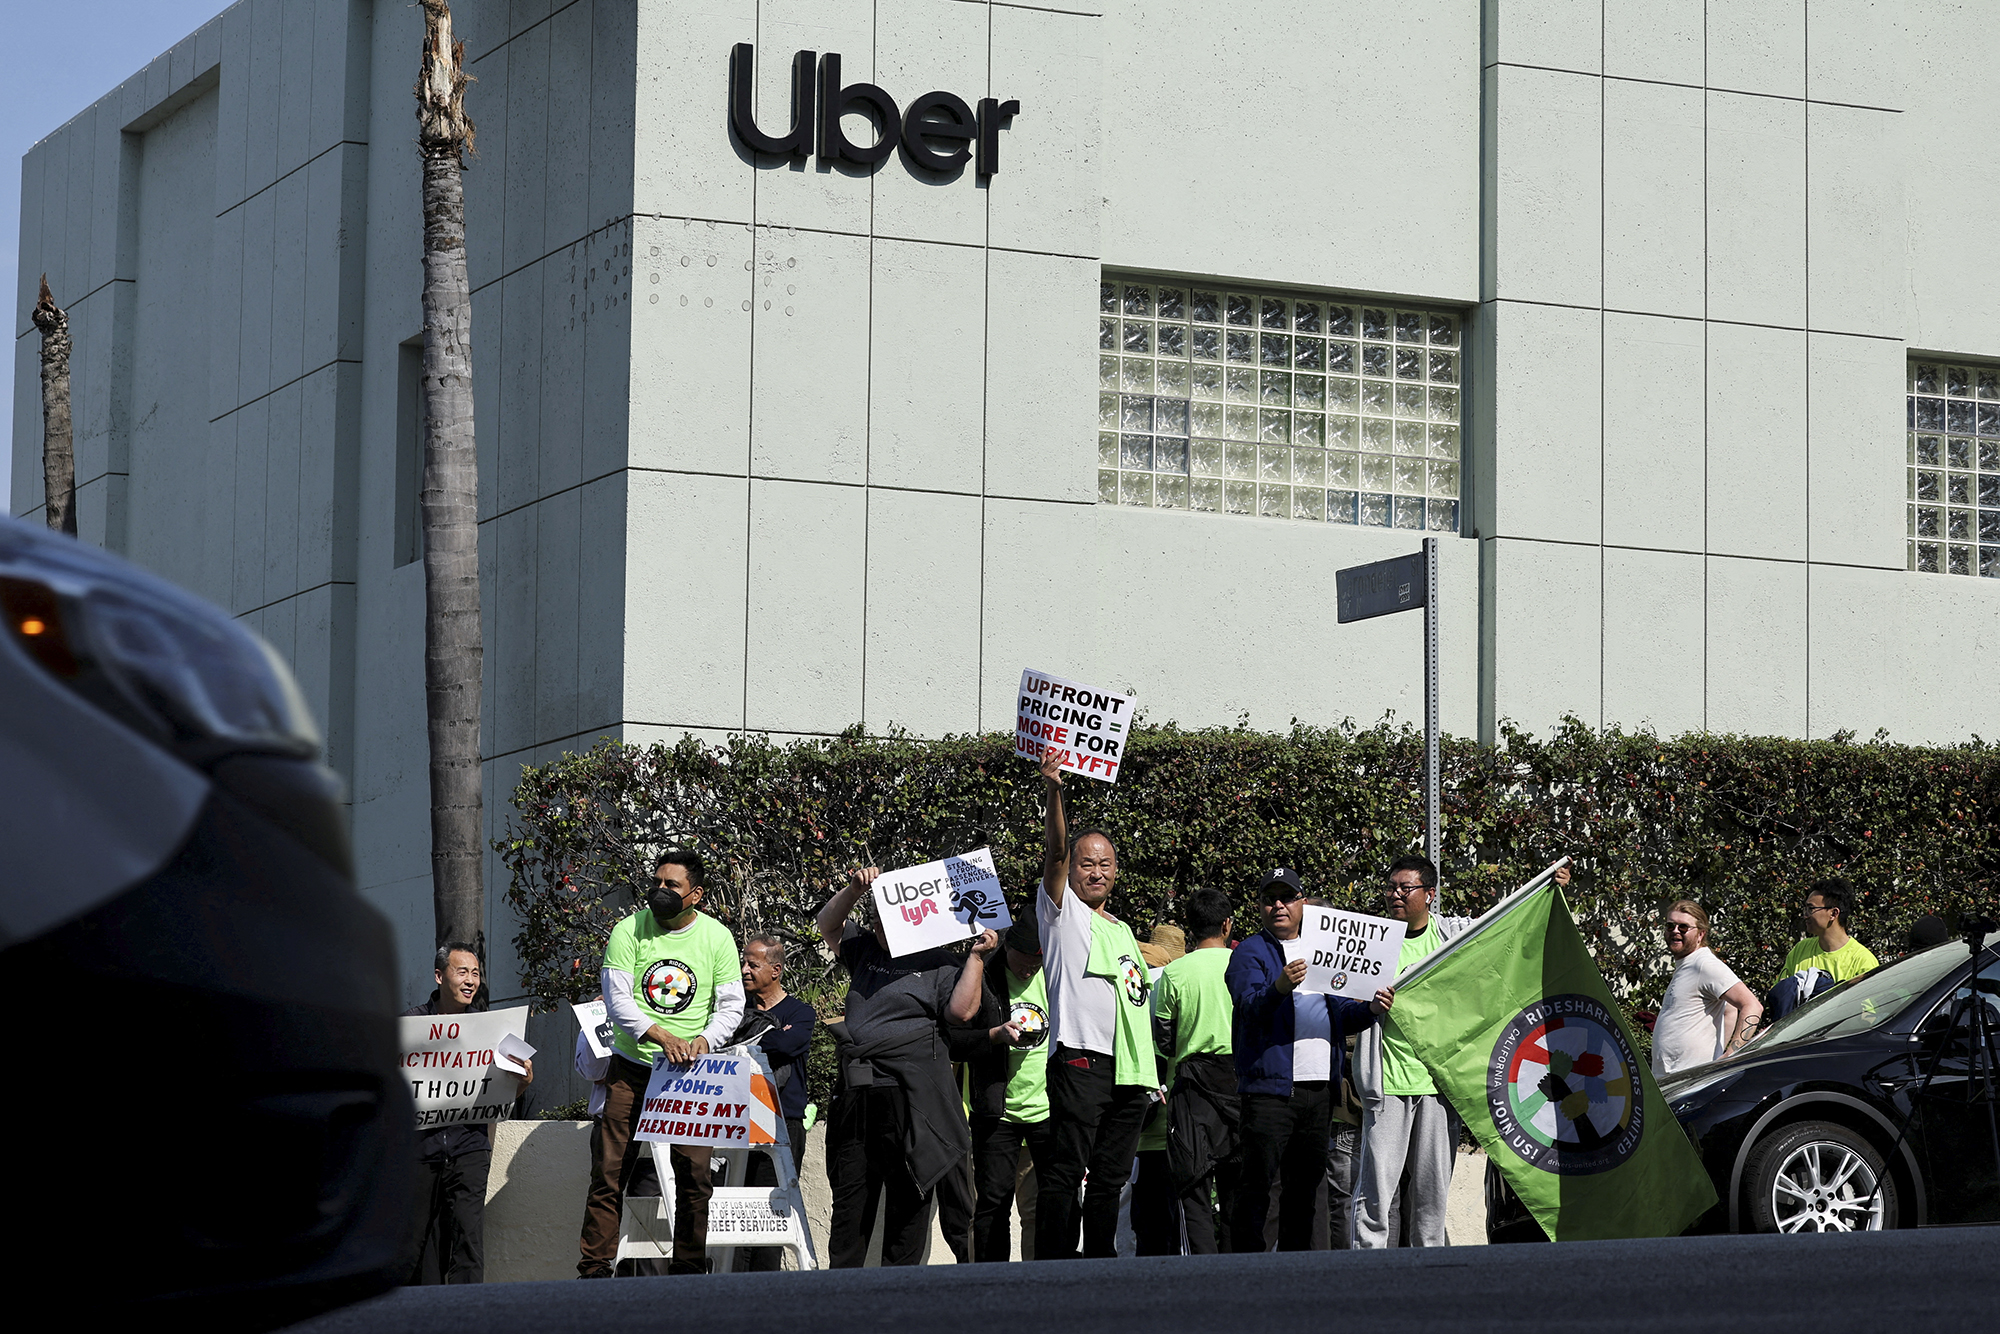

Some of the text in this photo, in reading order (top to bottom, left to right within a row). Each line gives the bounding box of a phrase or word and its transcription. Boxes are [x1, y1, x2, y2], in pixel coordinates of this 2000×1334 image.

[729, 42, 1020, 177] Uber
[1026, 676, 1125, 714] UPFRONT
[1020, 696, 1103, 730] PRICING
[1018, 716, 1120, 757] MORE FOR
[946, 856, 983, 871] STEALING
[956, 864, 977, 875] FROM
[944, 866, 992, 883] PASSENGERS
[946, 871, 995, 889] AND DRIVERS
[882, 878, 942, 906] Uber
[900, 898, 939, 926] lyft
[1319, 914, 1390, 941] DIGNITY
[1336, 935, 1367, 956] FOR
[1312, 949, 1383, 976] DRIVERS
[428, 1022, 460, 1041] NO
[398, 1049, 496, 1069] ACTIVATIO
[655, 1057, 667, 1071] 7
[1494, 1028, 1521, 1088] CALIFORNIA
[411, 1077, 492, 1099] THOUT
[660, 1079, 724, 1096] & 90Hrs
[1525, 1000, 1643, 1155] RIDESHARE DRIVERS UNITED
[644, 1098, 747, 1118] WHERE'S MY
[637, 1119, 746, 1140] FLEXIBILITY?
[1492, 1098, 1539, 1160] JOIN US!
[720, 1201, 729, 1210] OF
[730, 1201, 743, 1210] LOS
[744, 1201, 772, 1210] ANGELES
[720, 1209, 729, 1219] OF
[730, 1209, 757, 1219] PUBLIC
[760, 1209, 786, 1219] WORKS
[707, 1219, 788, 1232] TREET SERVICES
